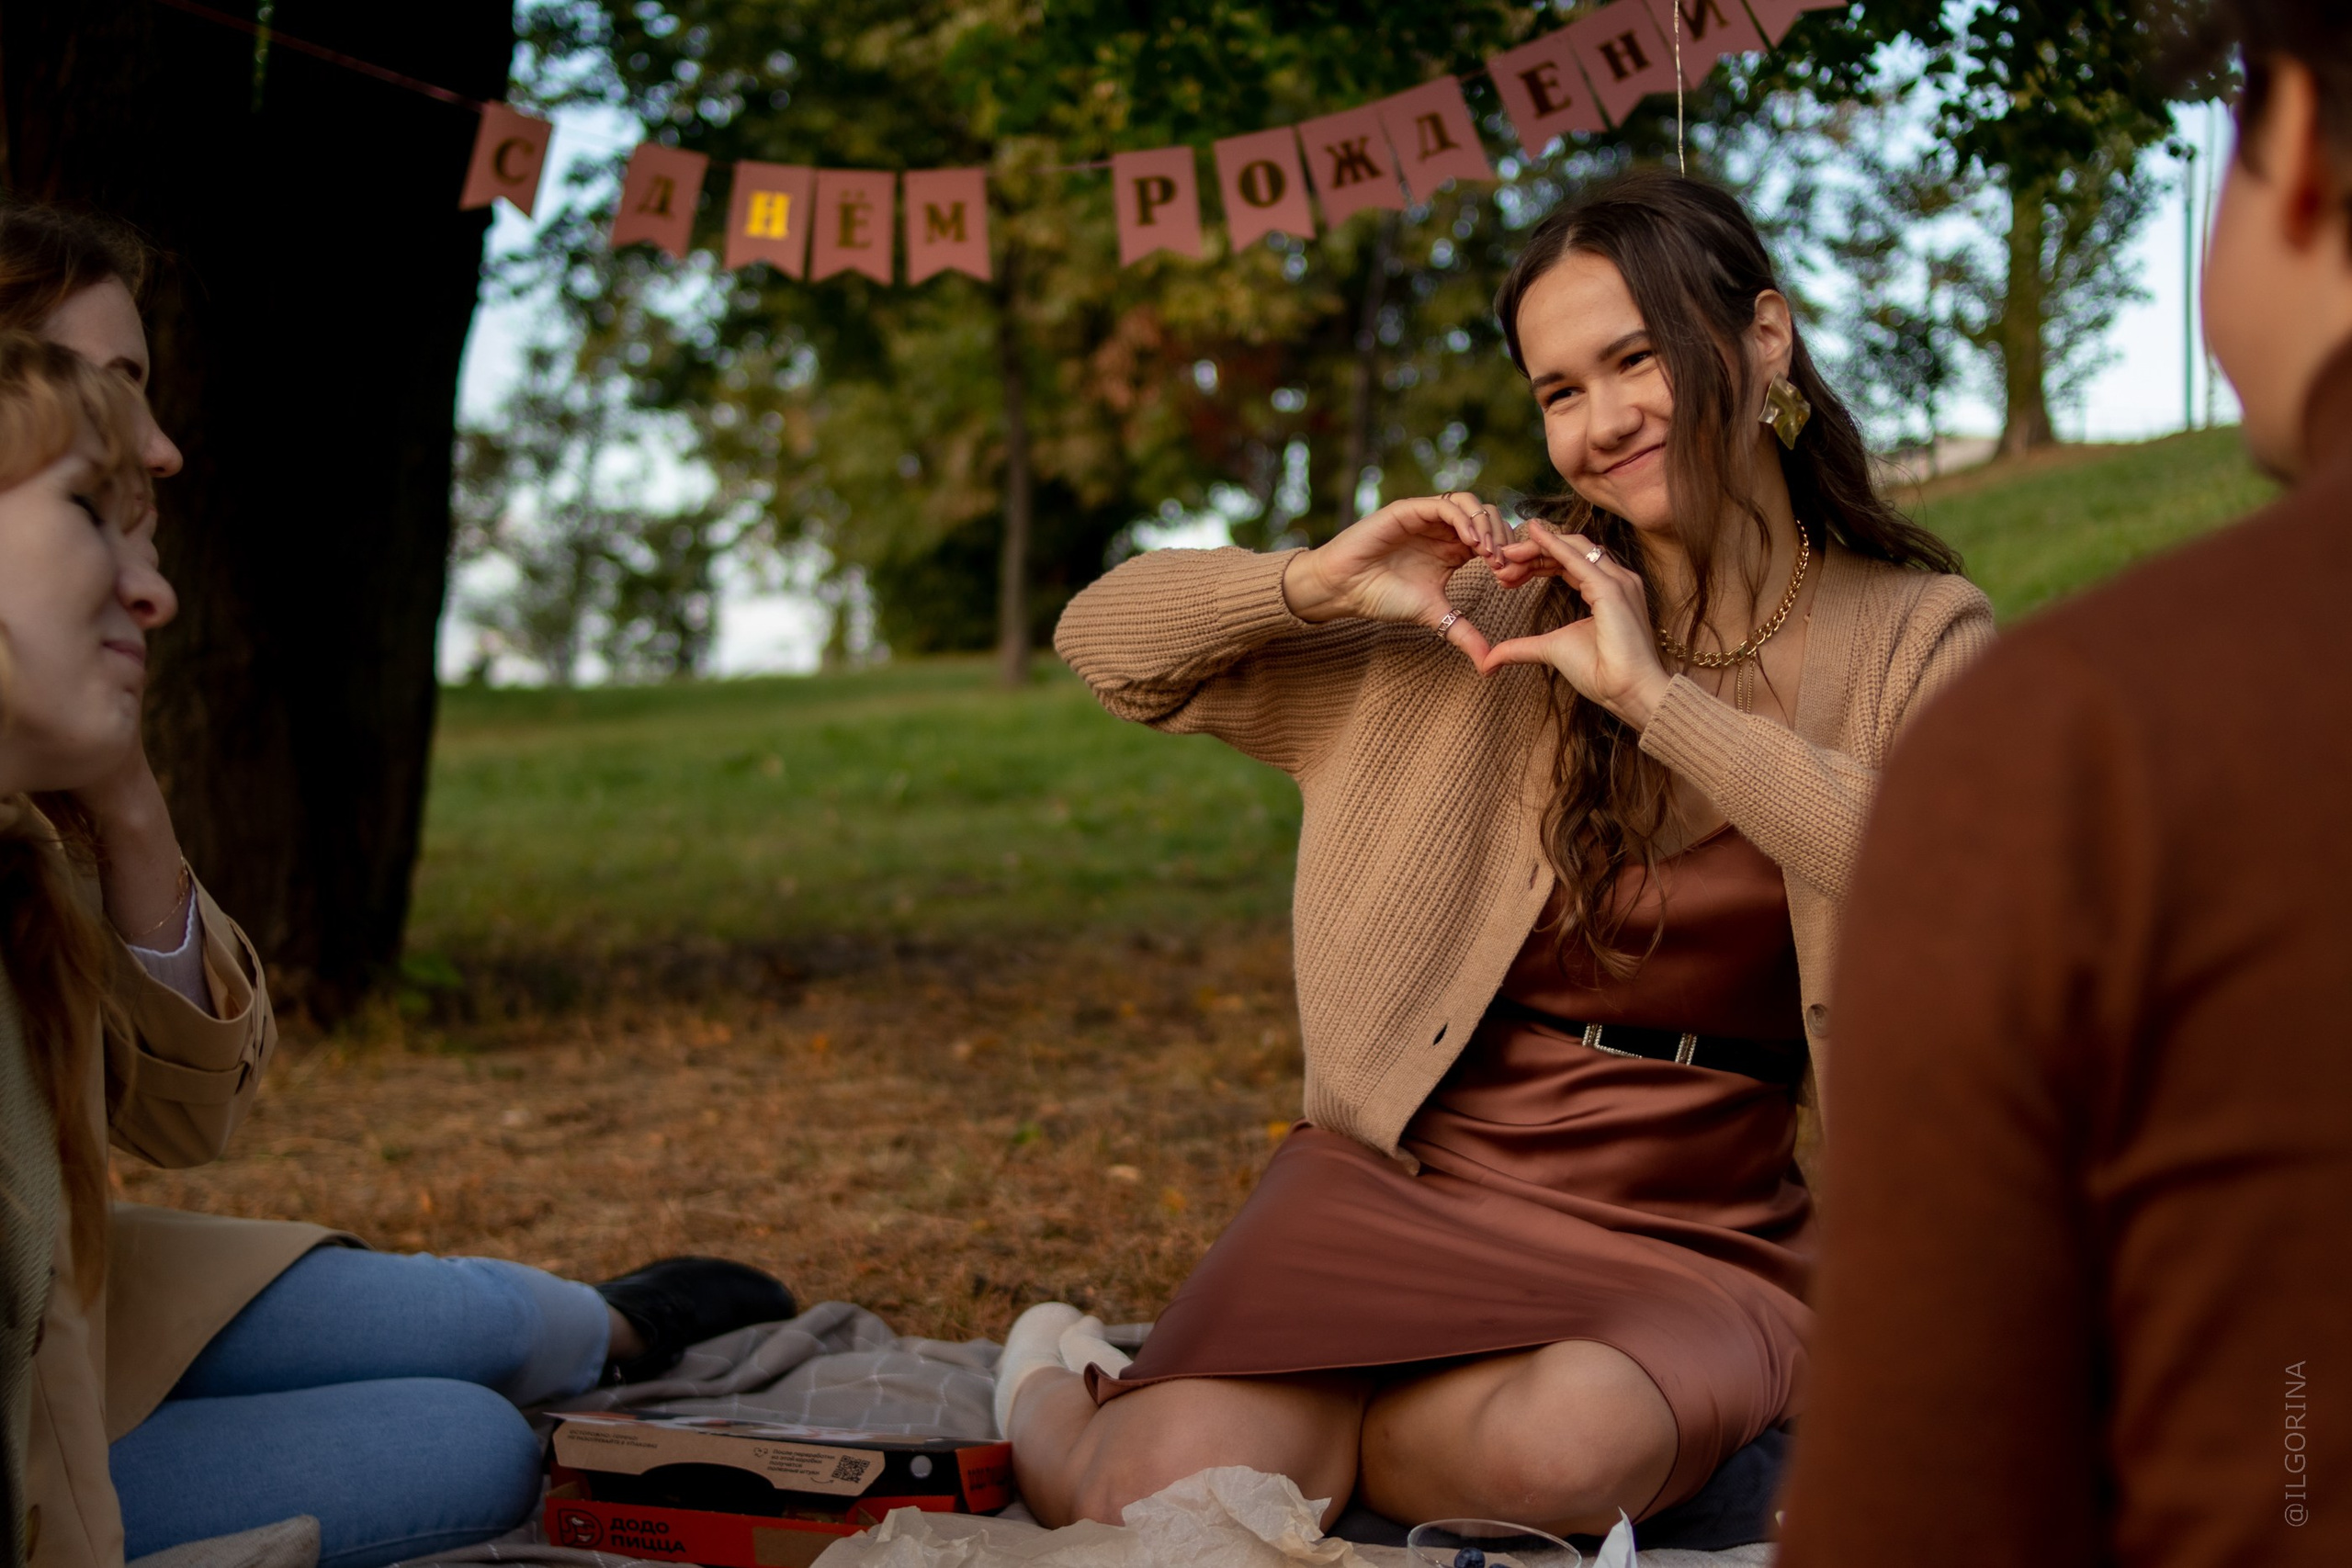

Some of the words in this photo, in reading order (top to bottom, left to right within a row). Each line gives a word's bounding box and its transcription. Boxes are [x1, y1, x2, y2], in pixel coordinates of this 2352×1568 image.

[493, 137, 535, 185] С
[637, 175, 967, 250] ДНЁМ
[793, 1451, 835, 1460] переработки
[766, 1465, 799, 1473] полезные
[768, 1460, 803, 1468] получатся
[610, 1517, 670, 1535] ДОДО
[611, 1534, 686, 1554] ПИЦЦА
